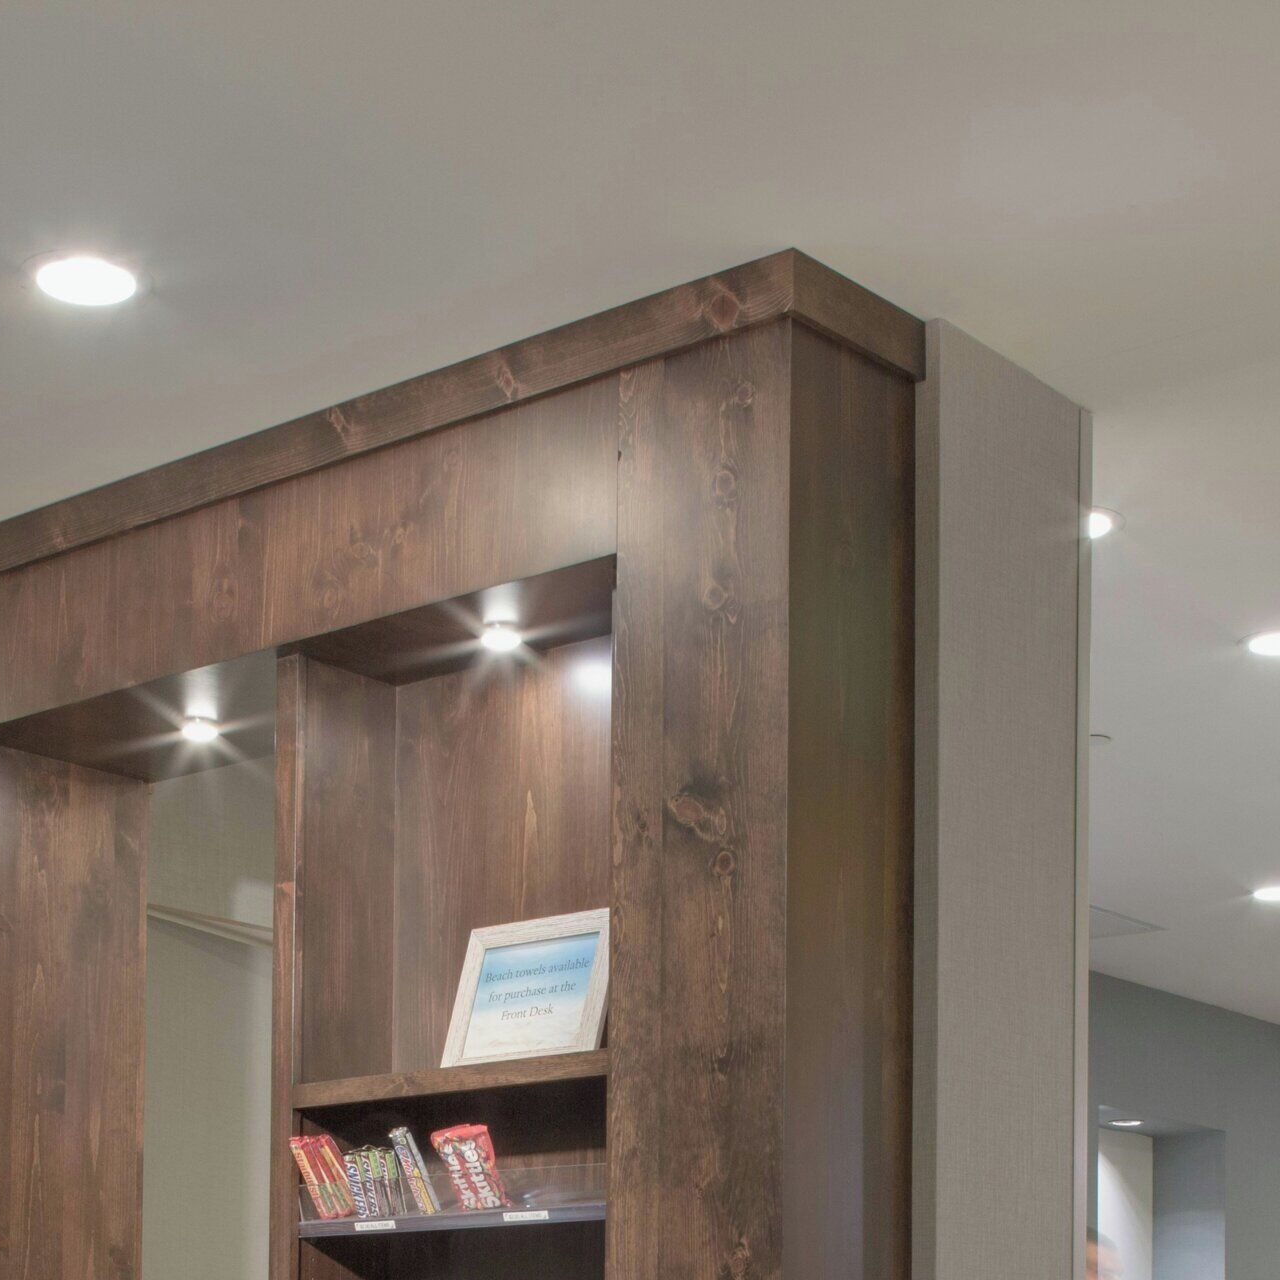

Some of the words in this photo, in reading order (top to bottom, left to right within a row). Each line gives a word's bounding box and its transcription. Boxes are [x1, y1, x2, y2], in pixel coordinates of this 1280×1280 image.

[485, 969, 513, 983] Beach
[515, 964, 546, 978] towels
[548, 958, 590, 973] available
[488, 991, 503, 1003] for
[504, 986, 547, 1003] purchase
[549, 985, 558, 993] at
[560, 981, 577, 991] the
[501, 1009, 526, 1021] Front
[529, 1004, 554, 1017] Desk
